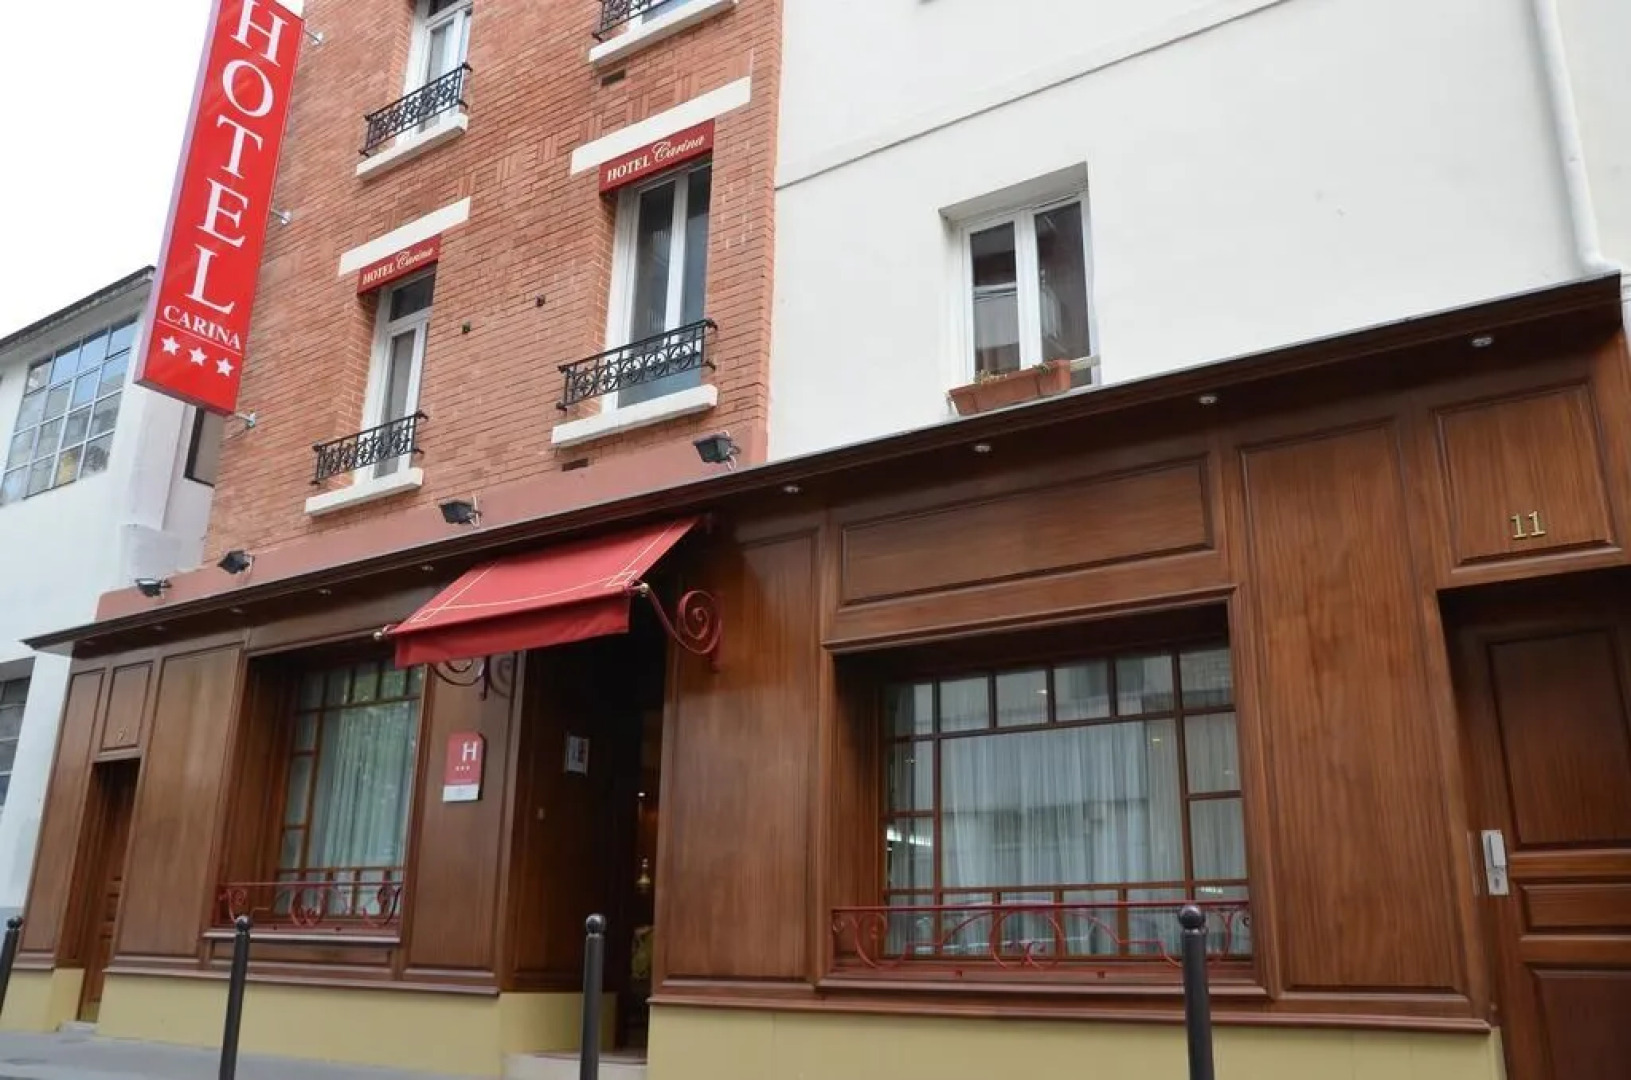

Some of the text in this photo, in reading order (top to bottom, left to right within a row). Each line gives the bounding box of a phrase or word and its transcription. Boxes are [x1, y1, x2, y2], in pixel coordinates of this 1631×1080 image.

[184, 0, 289, 315] HOTEL
[607, 135, 705, 182] HOTEL Carina
[362, 247, 434, 285] HOTEL Carina
[163, 305, 241, 350] CARINA
[1510, 511, 1546, 538] 11
[462, 741, 478, 762] H
